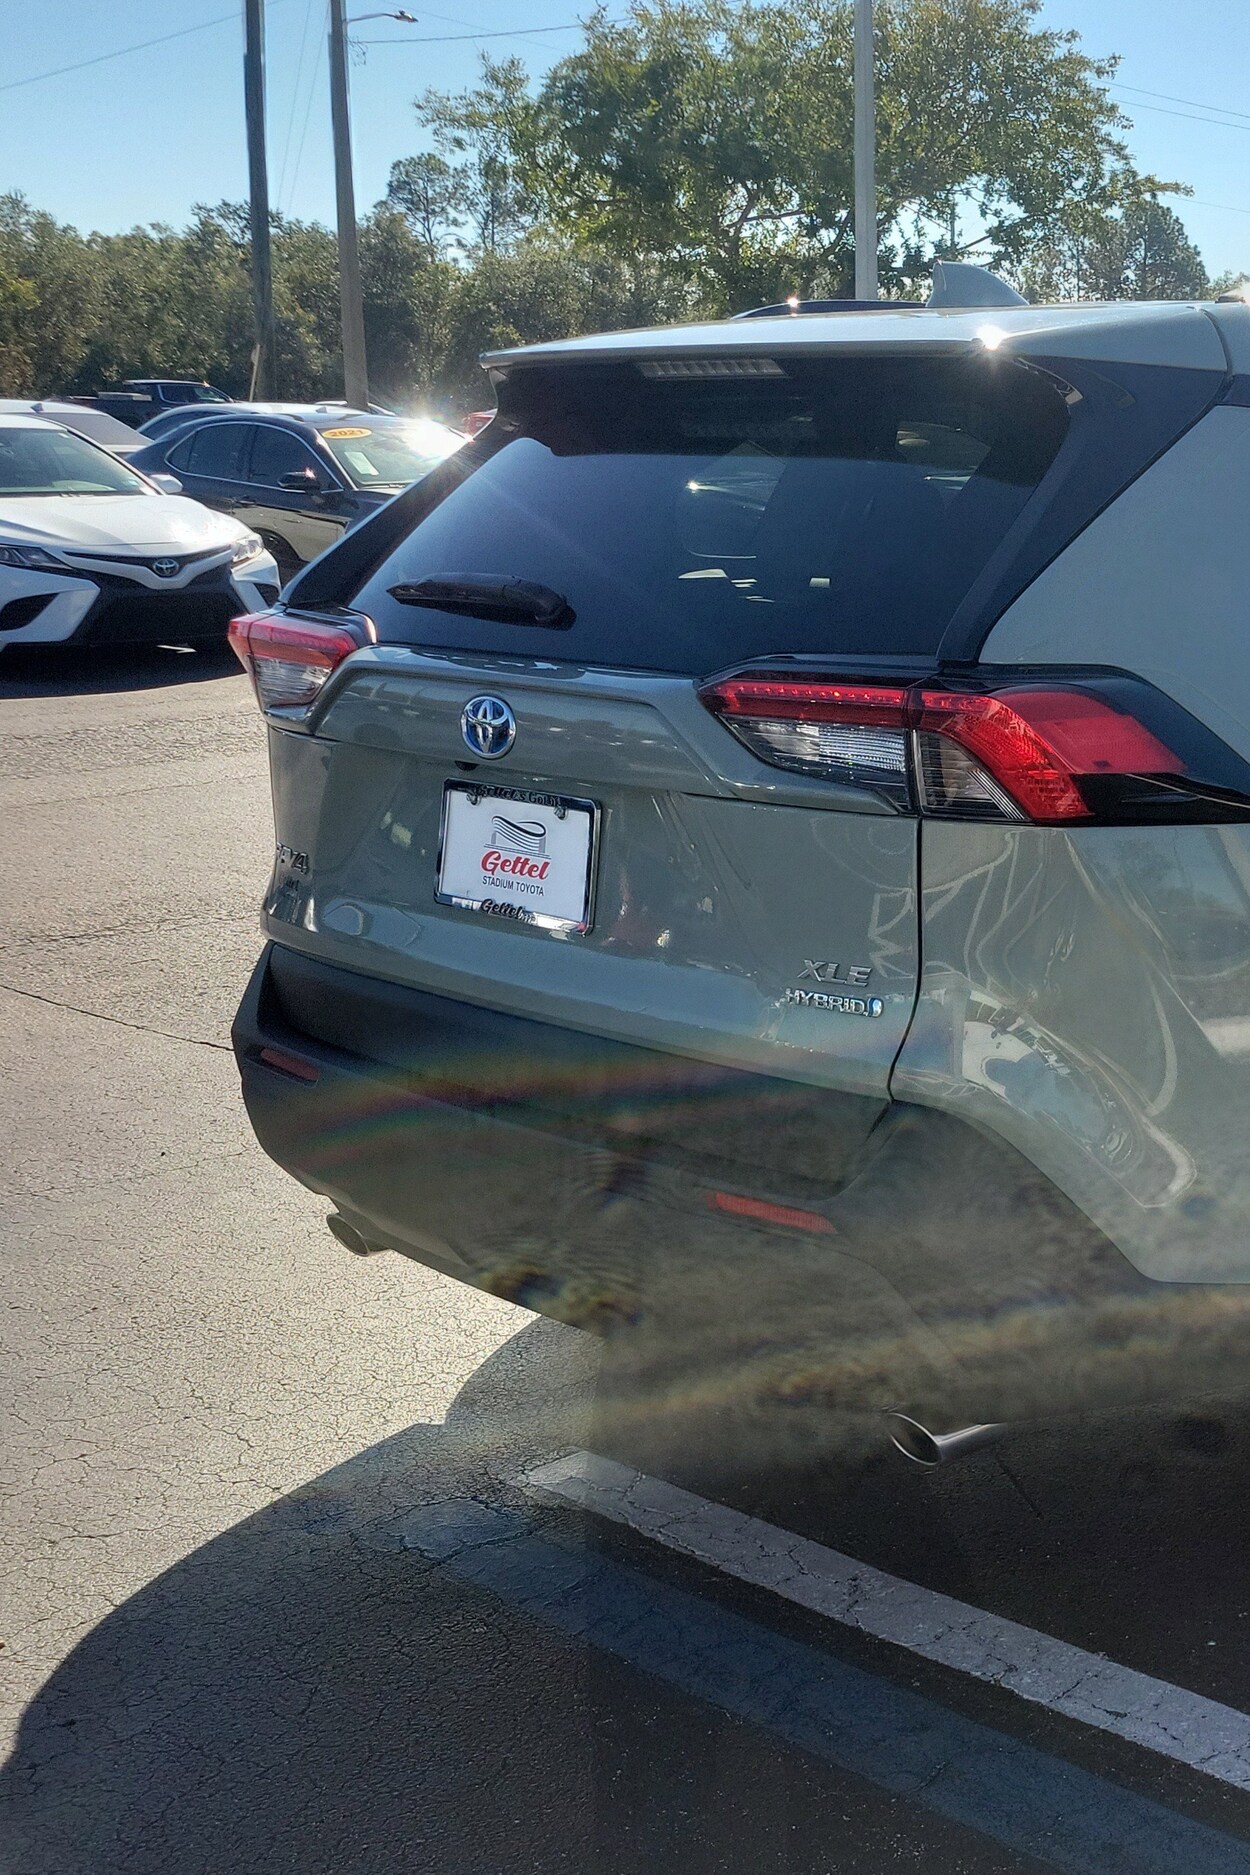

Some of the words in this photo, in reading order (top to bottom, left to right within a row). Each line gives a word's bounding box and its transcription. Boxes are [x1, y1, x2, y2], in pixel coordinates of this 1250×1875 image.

[329, 429, 365, 437] 2021
[277, 842, 309, 875] AV4
[481, 850, 551, 880] Gettel
[482, 875, 514, 890] STADIUM
[515, 881, 545, 896] TOYOTA
[797, 959, 872, 987] XLE
[785, 987, 866, 1017] HYBRID
